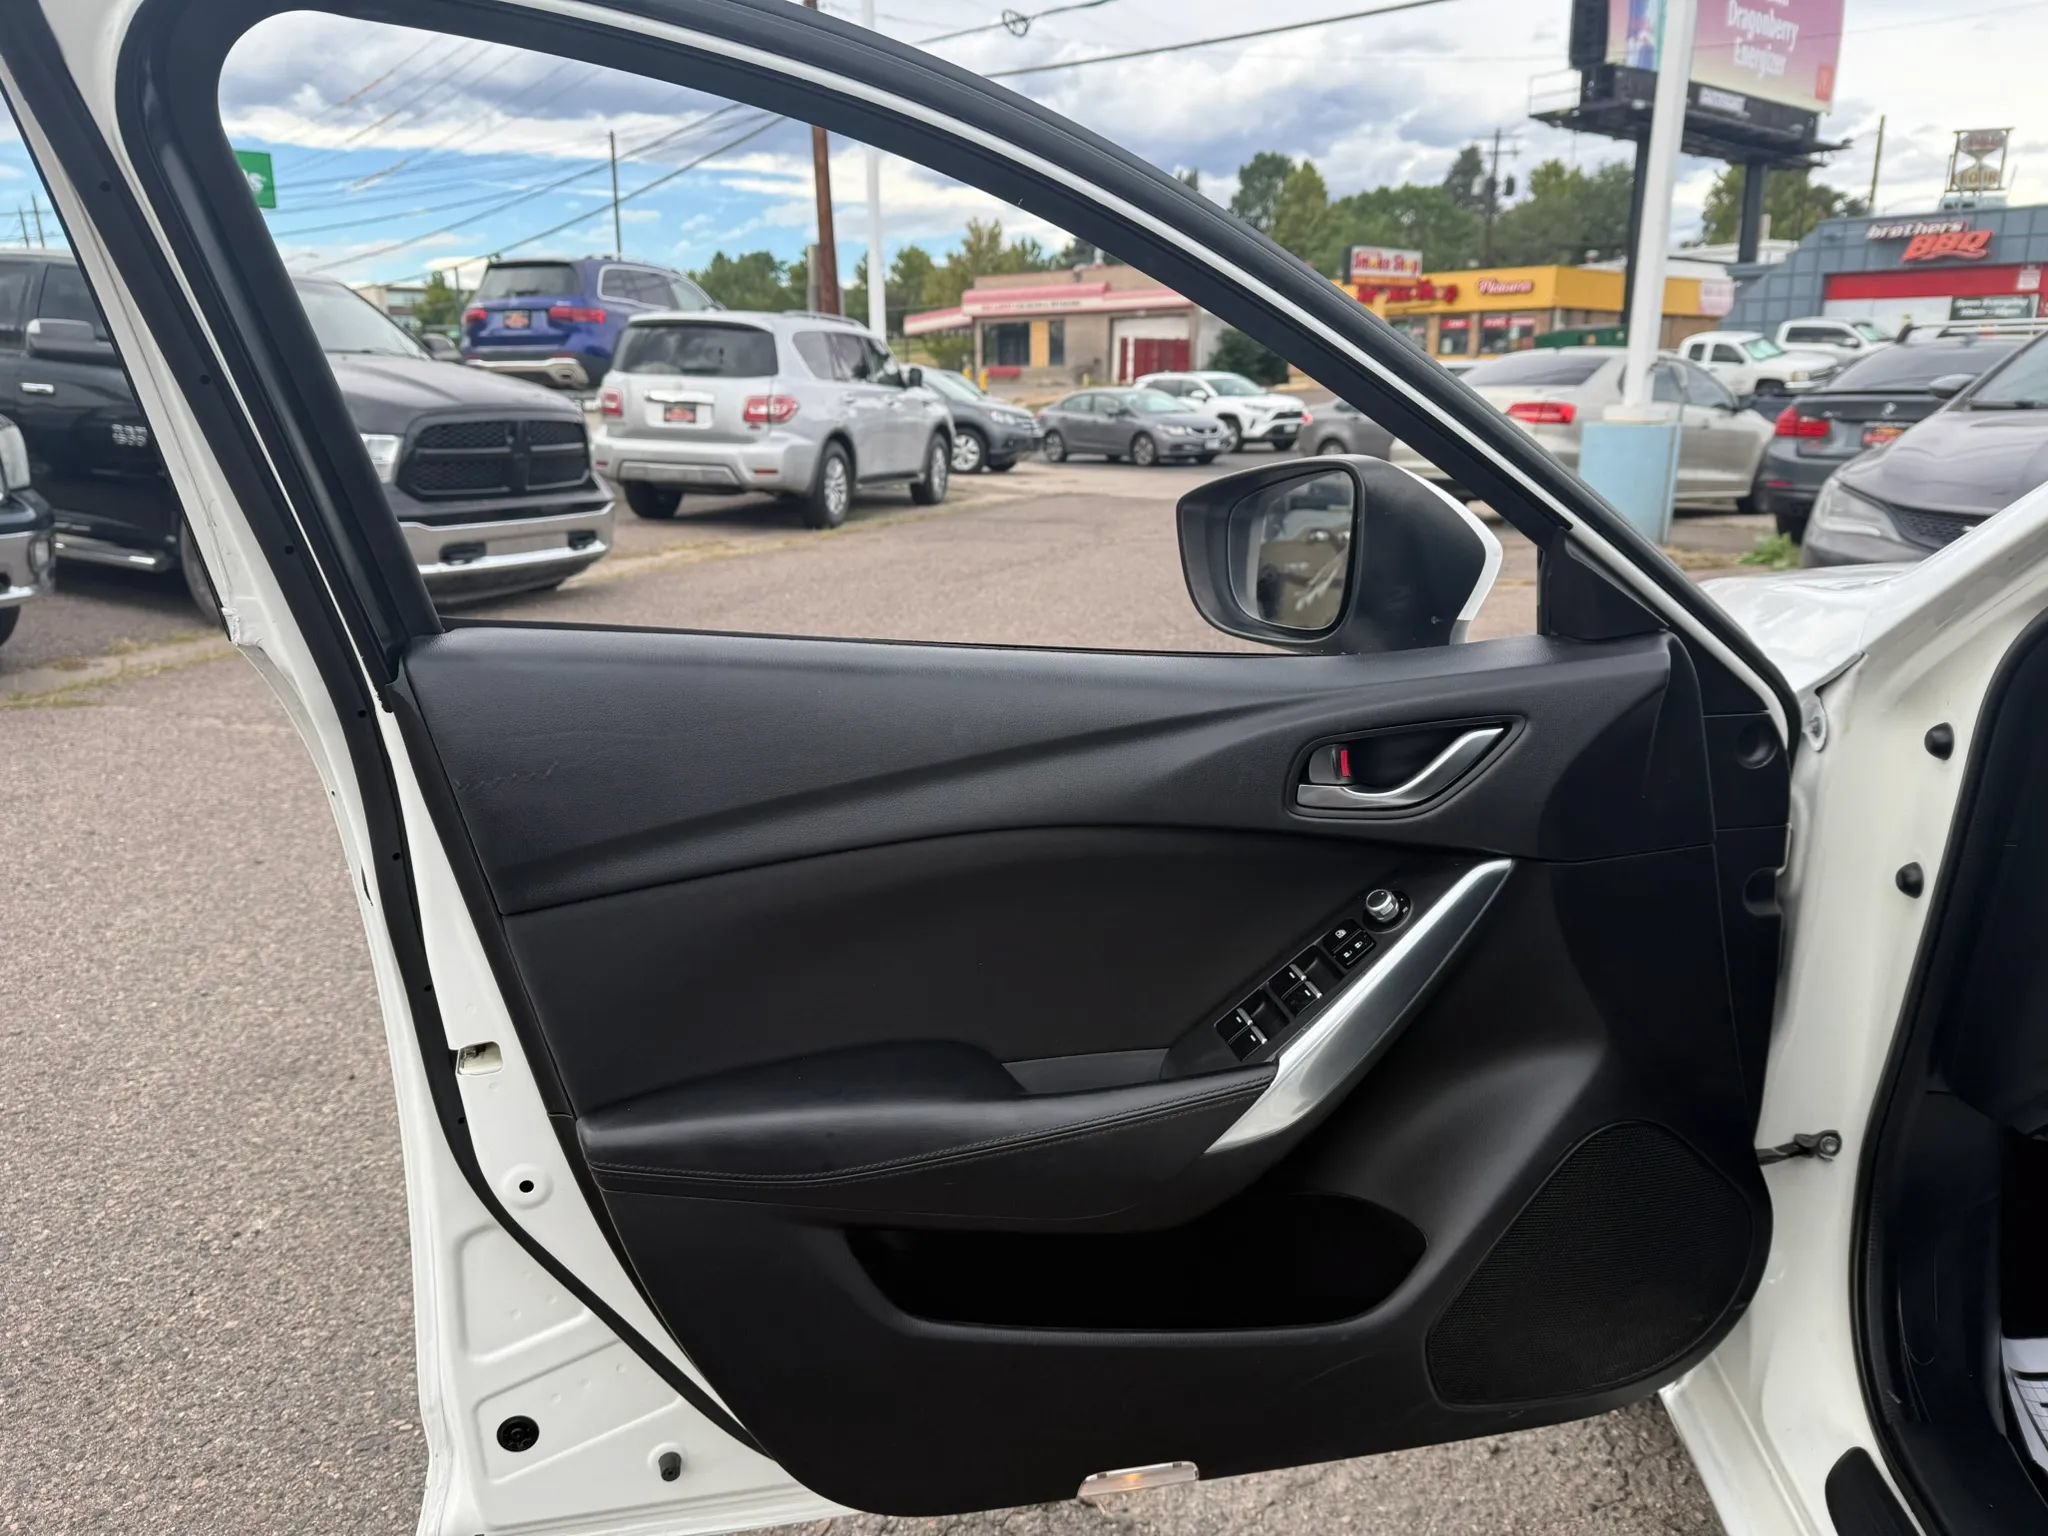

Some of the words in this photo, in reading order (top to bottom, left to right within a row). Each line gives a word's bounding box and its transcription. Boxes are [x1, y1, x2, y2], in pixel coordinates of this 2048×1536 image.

[1727, 0, 1799, 52] Dragonberry
[1734, 37, 1787, 79] Energizer
[1866, 222, 1964, 240] brothers
[1903, 231, 1992, 261] BBQ
